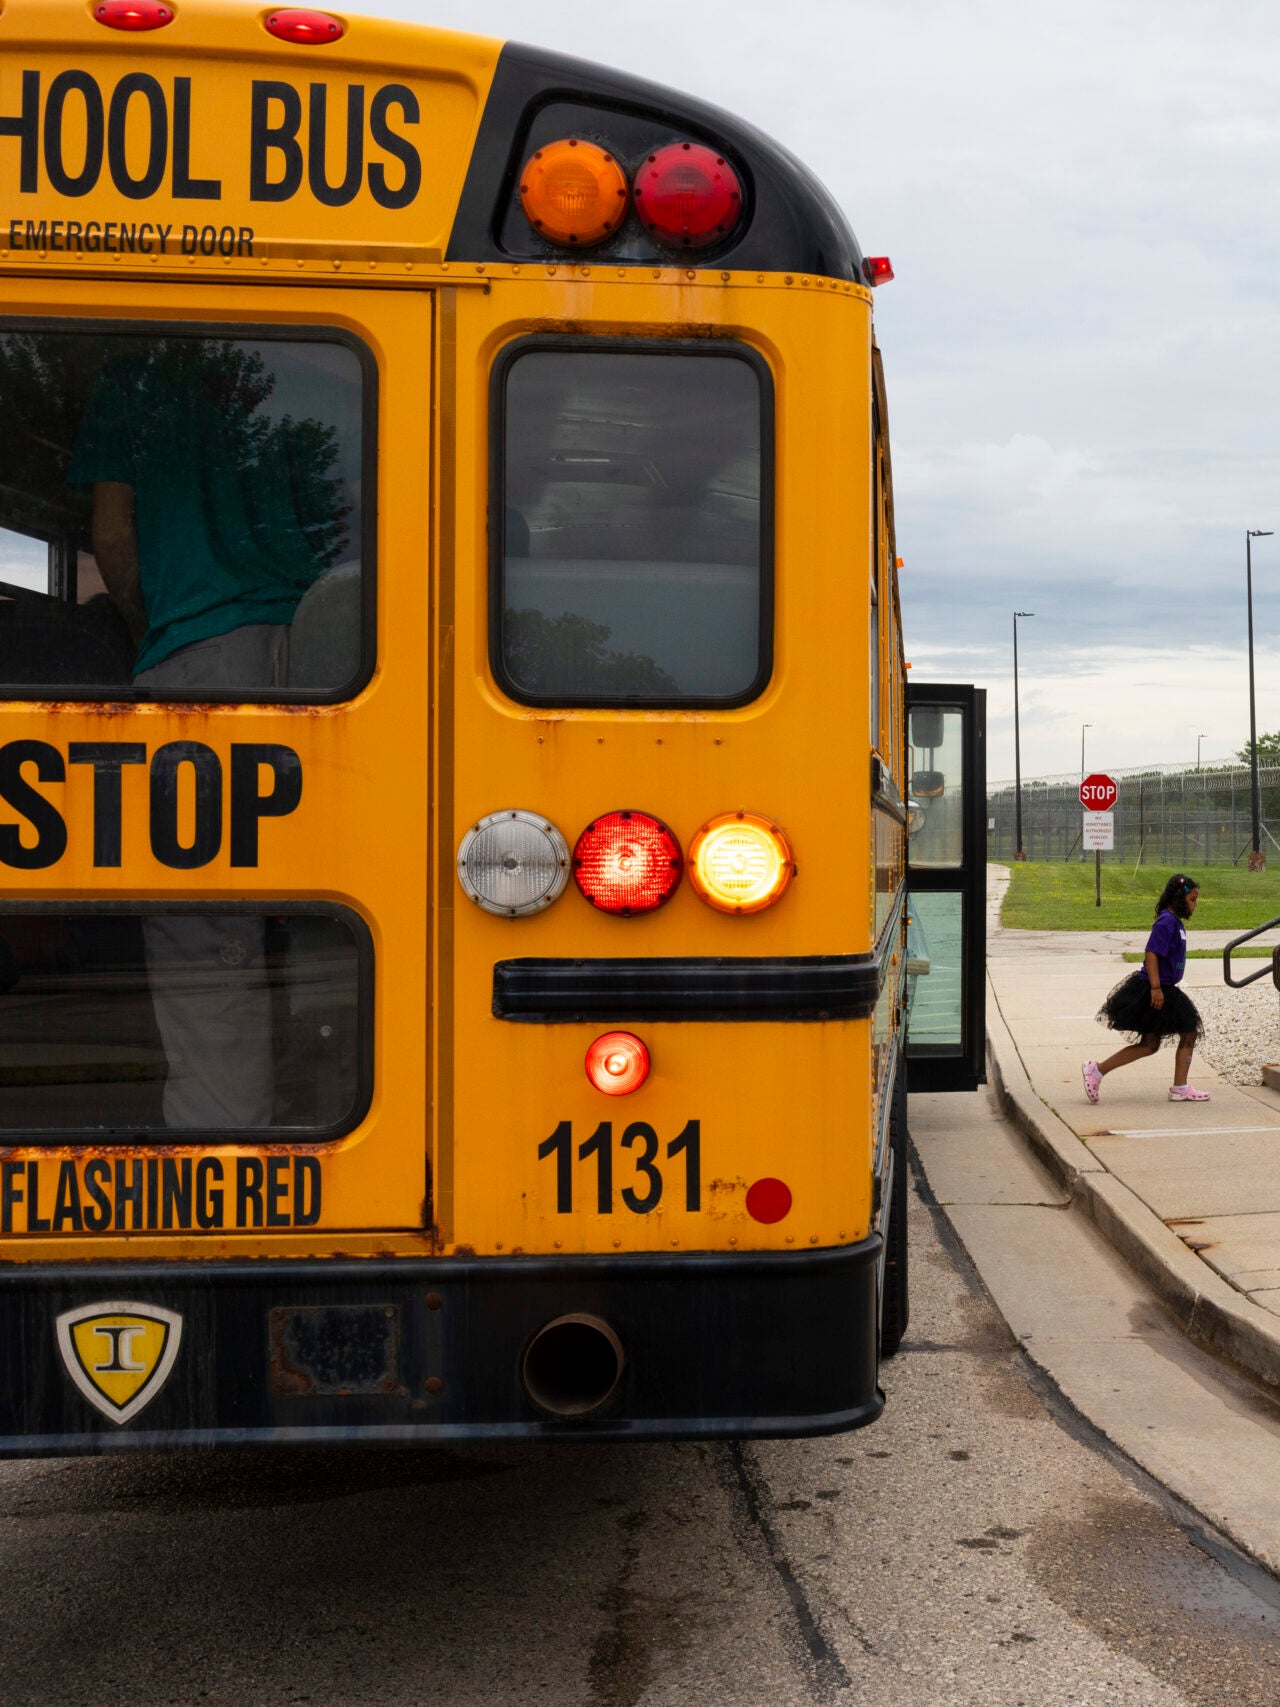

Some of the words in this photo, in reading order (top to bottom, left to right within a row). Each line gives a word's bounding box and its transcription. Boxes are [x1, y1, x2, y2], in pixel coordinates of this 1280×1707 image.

[250, 80, 422, 209] BUS
[10, 220, 172, 254] EMERGENCY
[182, 225, 254, 256] DOOR
[0, 740, 303, 869] STOP
[1081, 785, 1115, 800] STOP
[2, 1156, 224, 1232] FLASHING
[236, 1156, 322, 1227] RED
[538, 1120, 701, 1214] 1131
